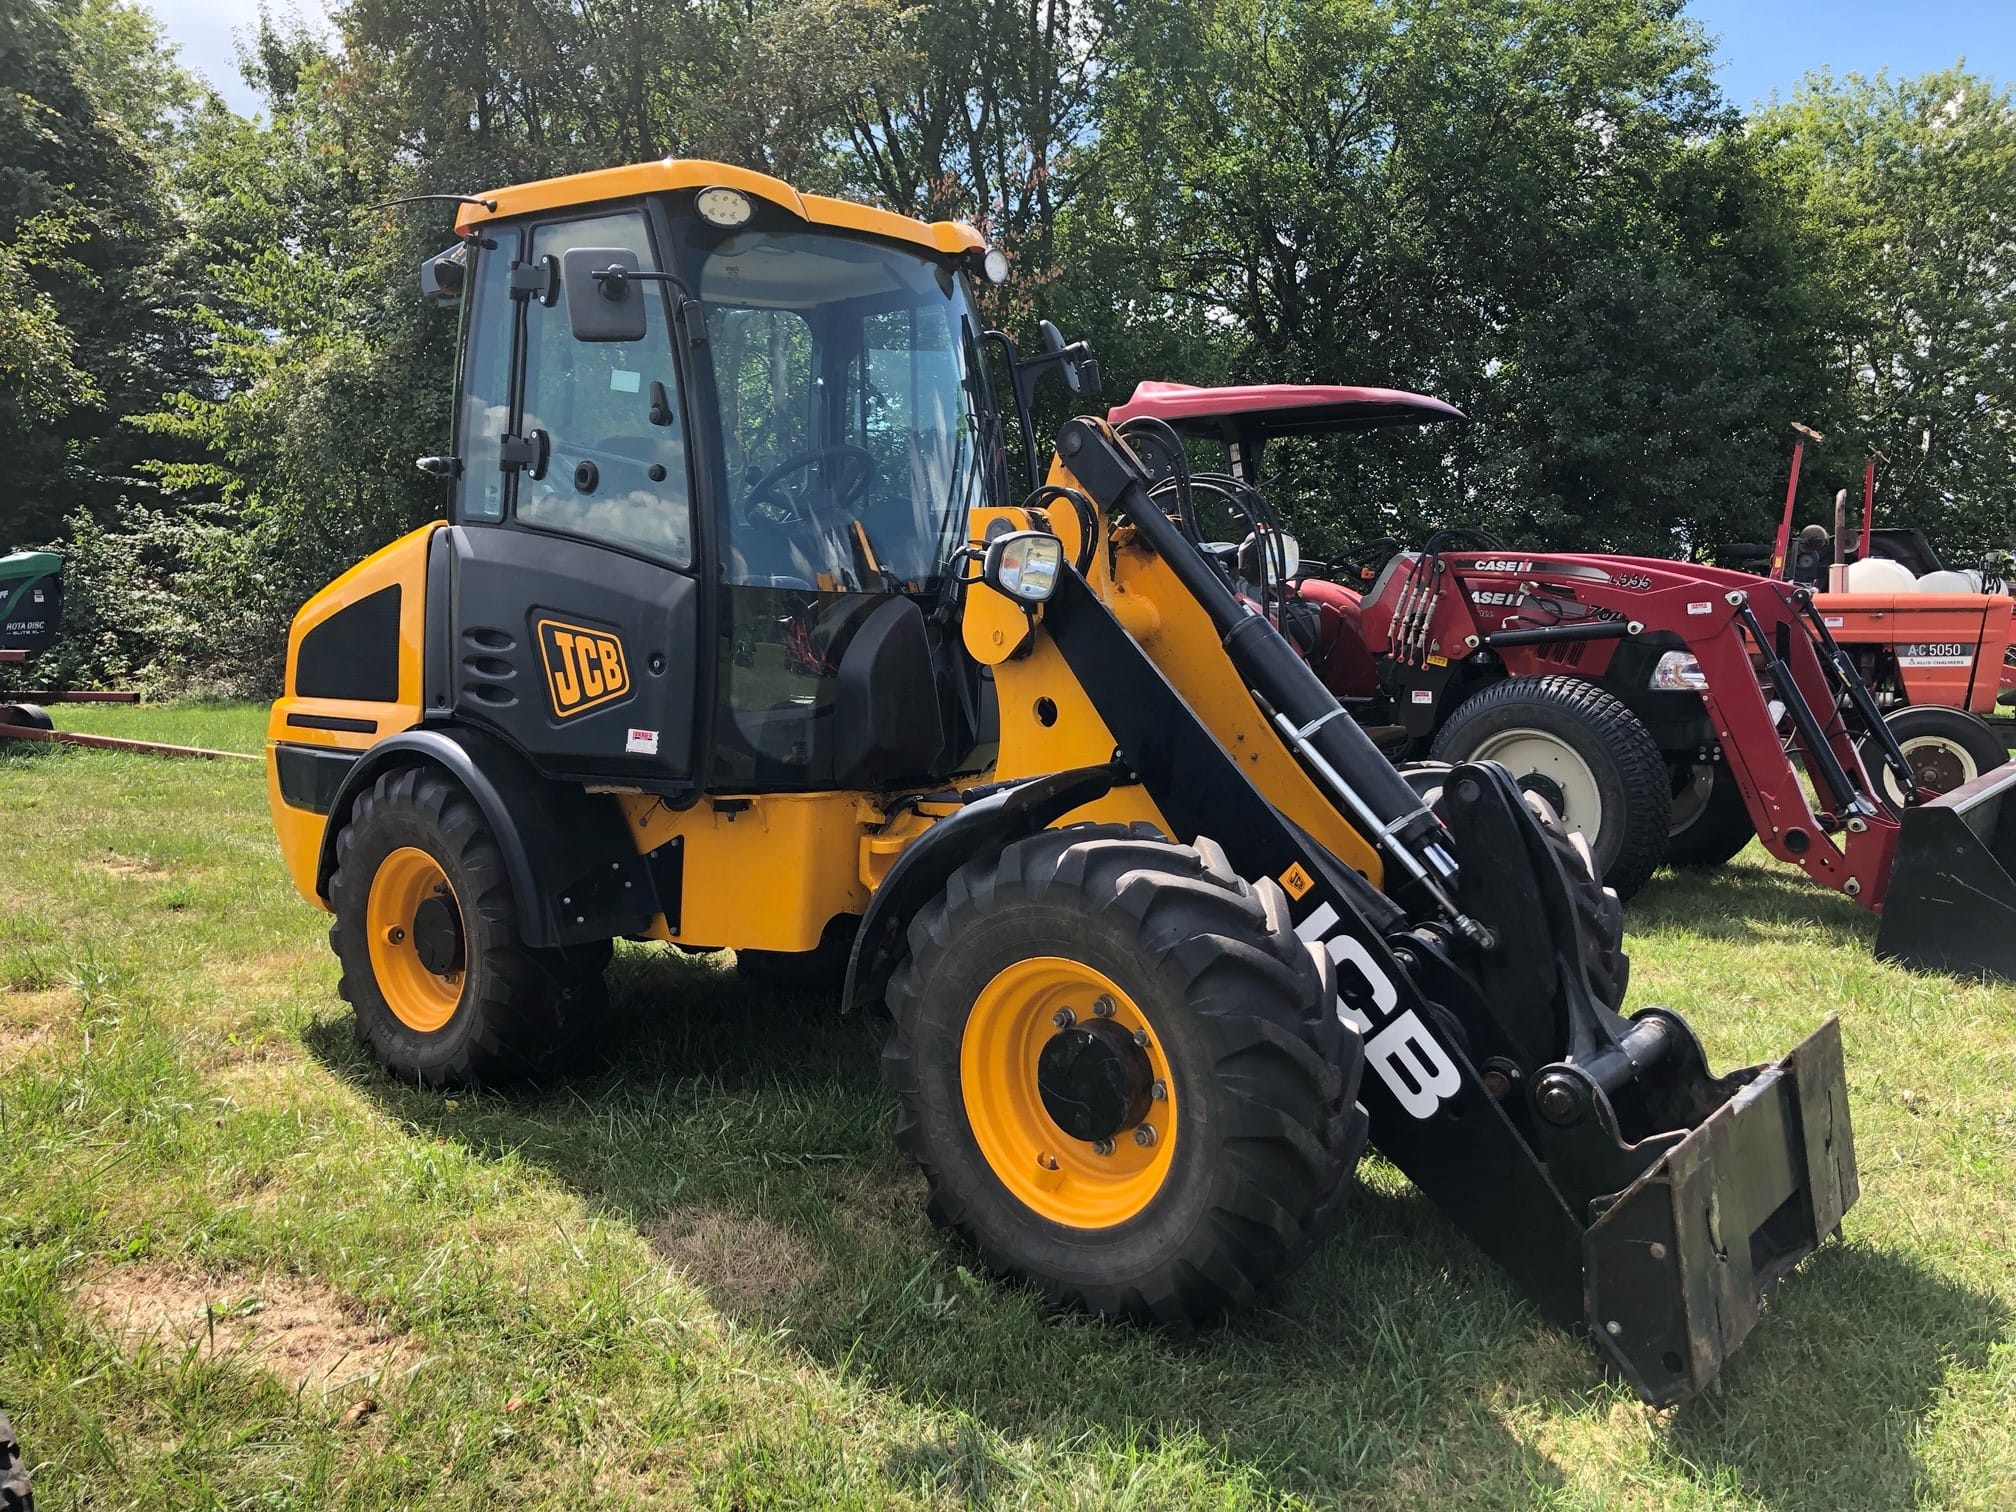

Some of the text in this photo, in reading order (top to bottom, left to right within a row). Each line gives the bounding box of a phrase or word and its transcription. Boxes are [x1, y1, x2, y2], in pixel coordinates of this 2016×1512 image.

[1474, 560, 1517, 572] CASE
[1471, 591, 1505, 605] ASE
[6, 621, 45, 630] ROTA DISC
[1929, 644, 1961, 656] 5050
[553, 630, 623, 706] JCB
[1289, 871, 1304, 890] JCB
